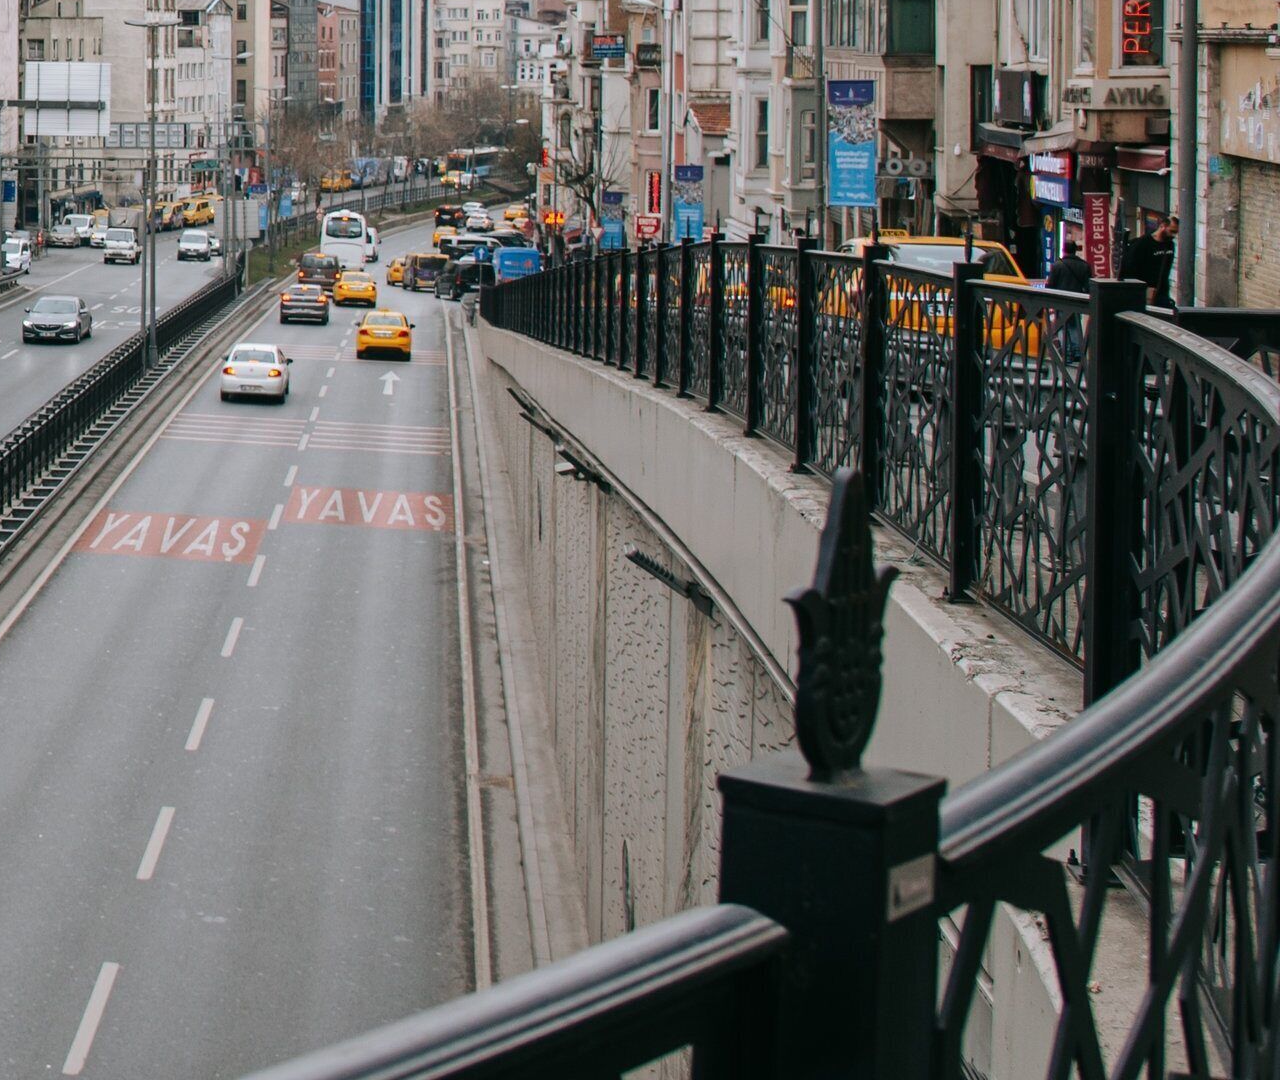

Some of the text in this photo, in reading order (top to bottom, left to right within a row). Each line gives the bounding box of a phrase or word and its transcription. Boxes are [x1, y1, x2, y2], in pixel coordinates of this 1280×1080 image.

[1104, 85, 1164, 105] AYTUĞ
[1092, 197, 1105, 279] YTUĞ PERUK
[91, 513, 250, 562] YAVAŞ
